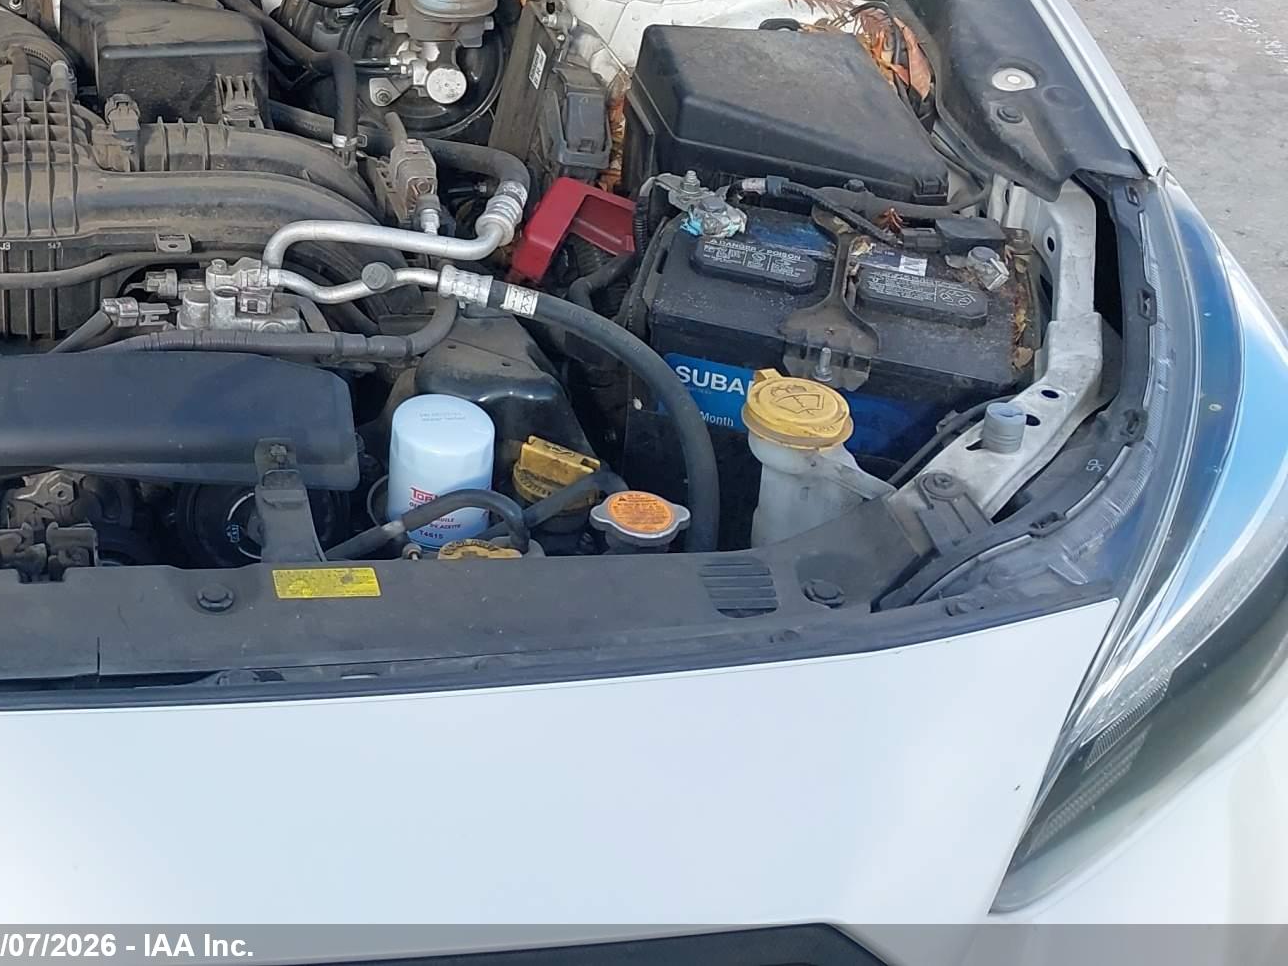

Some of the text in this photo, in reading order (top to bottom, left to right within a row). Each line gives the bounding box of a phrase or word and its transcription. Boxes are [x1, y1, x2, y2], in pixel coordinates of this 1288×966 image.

[718, 240, 756, 252] DANGER
[766, 249, 801, 260] POISON
[699, 411, 734, 427] Month
[1086, 458, 1104, 472] SP
